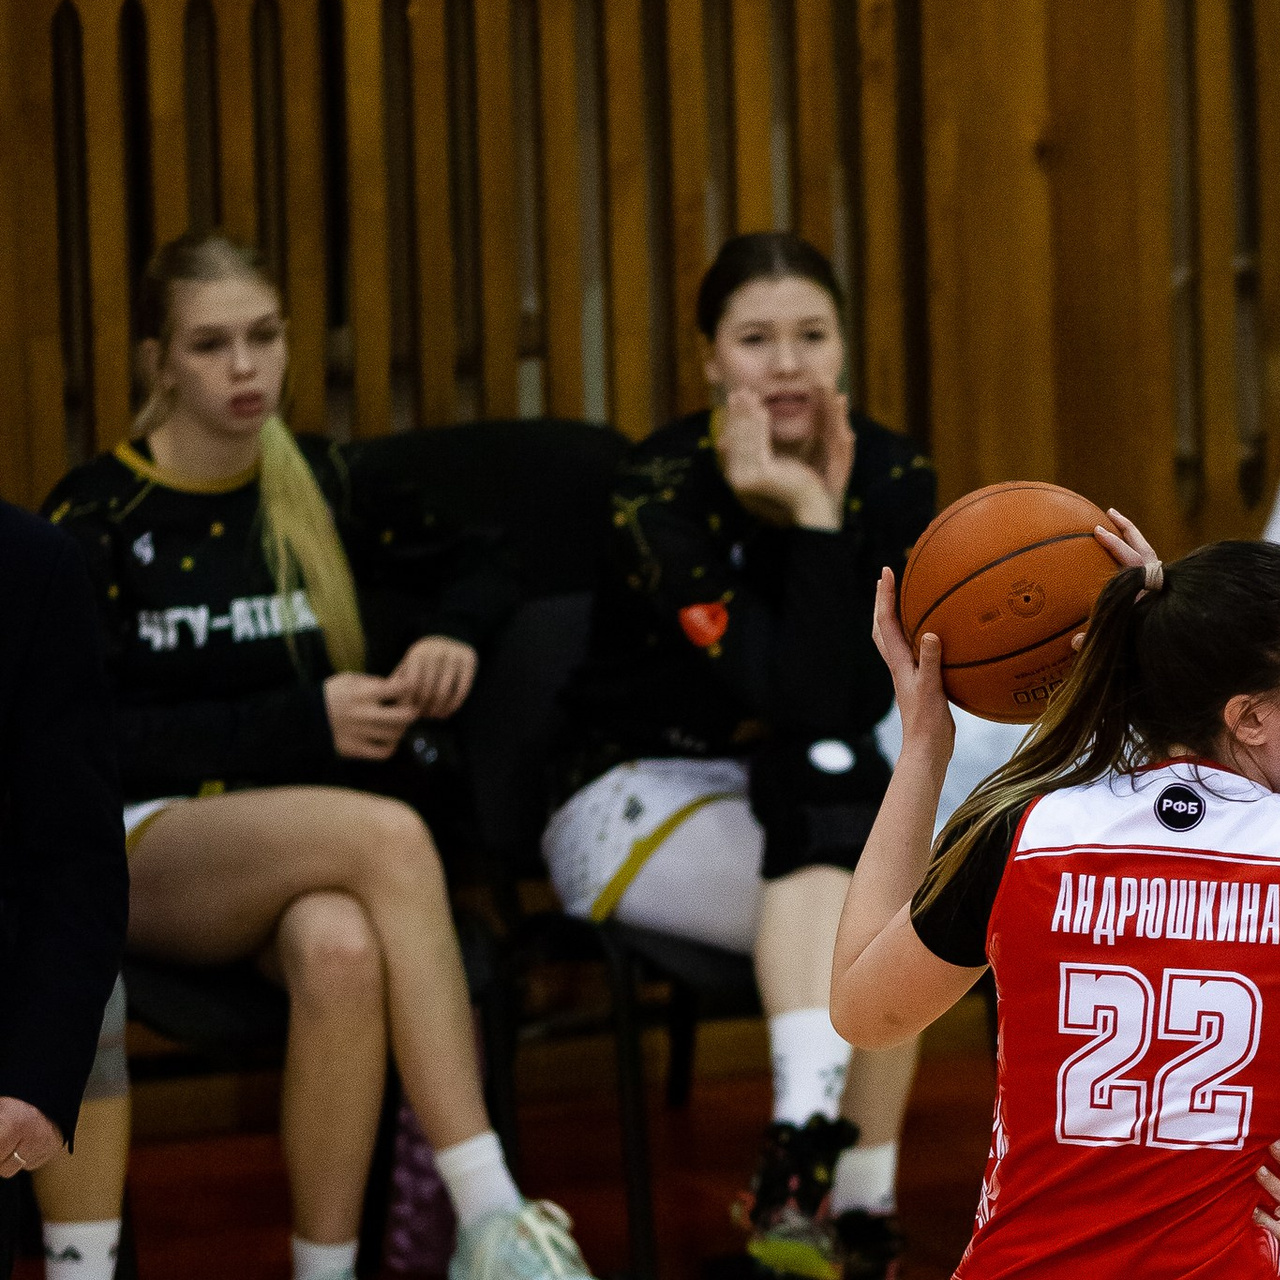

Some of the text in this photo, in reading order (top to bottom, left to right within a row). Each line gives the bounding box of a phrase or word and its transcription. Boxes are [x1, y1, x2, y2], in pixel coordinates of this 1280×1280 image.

[1162, 798, 1199, 816] РФБ
[1051, 871, 1280, 946] АНДРЮШКИНА
[1055, 961, 1263, 1151] 22
